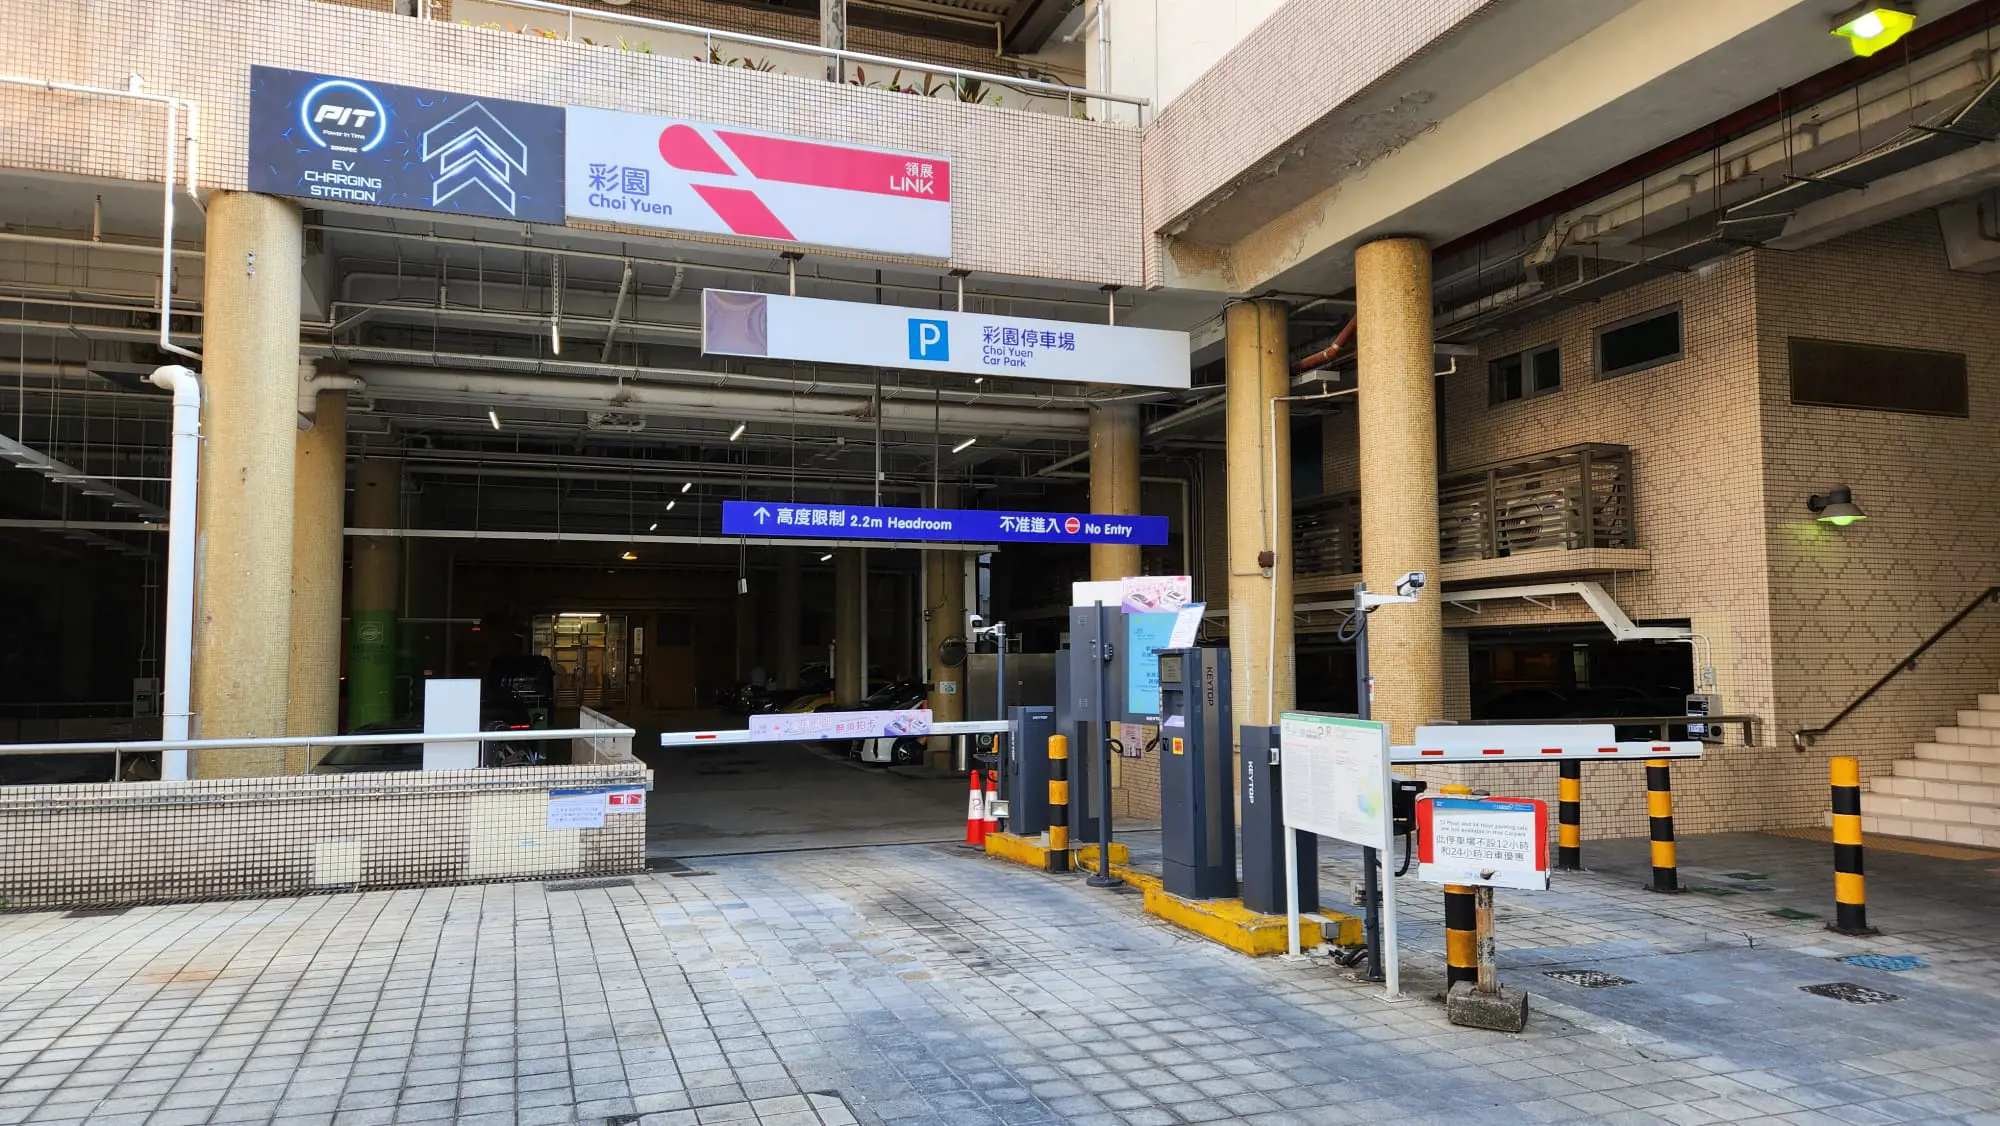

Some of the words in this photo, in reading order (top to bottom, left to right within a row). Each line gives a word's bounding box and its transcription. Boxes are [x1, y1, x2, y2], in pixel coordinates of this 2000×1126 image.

[313, 104, 377, 128] PIT
[322, 129, 343, 137] Power
[351, 132, 366, 140] Time
[332, 160, 355, 172] EV
[904, 161, 935, 179] 領展
[304, 170, 382, 189] CHARGING
[588, 163, 650, 196] 彩園
[890, 176, 935, 195] LINK
[310, 185, 376, 202] STATION
[588, 194, 627, 212] Choi
[630, 199, 673, 216] Yuen
[920, 323, 941, 357] P
[983, 326, 1076, 351] 彩園停車場
[983, 345, 1006, 356] Choi
[1008, 347, 1033, 358] Yuen
[983, 355, 1001, 365] Car
[1003, 357, 1027, 367] Park
[776, 508, 846, 527] 高度限制
[850, 515, 883, 528] 2.2m
[887, 516, 953, 531] Headroom
[1000, 516, 1061, 533] 不准進入
[1085, 523, 1101, 534] No
[1104, 523, 1133, 538] Entry
[1206, 666, 1214, 706] KEYTOP
[1436, 835, 1529, 850] 此停車場不設12小時
